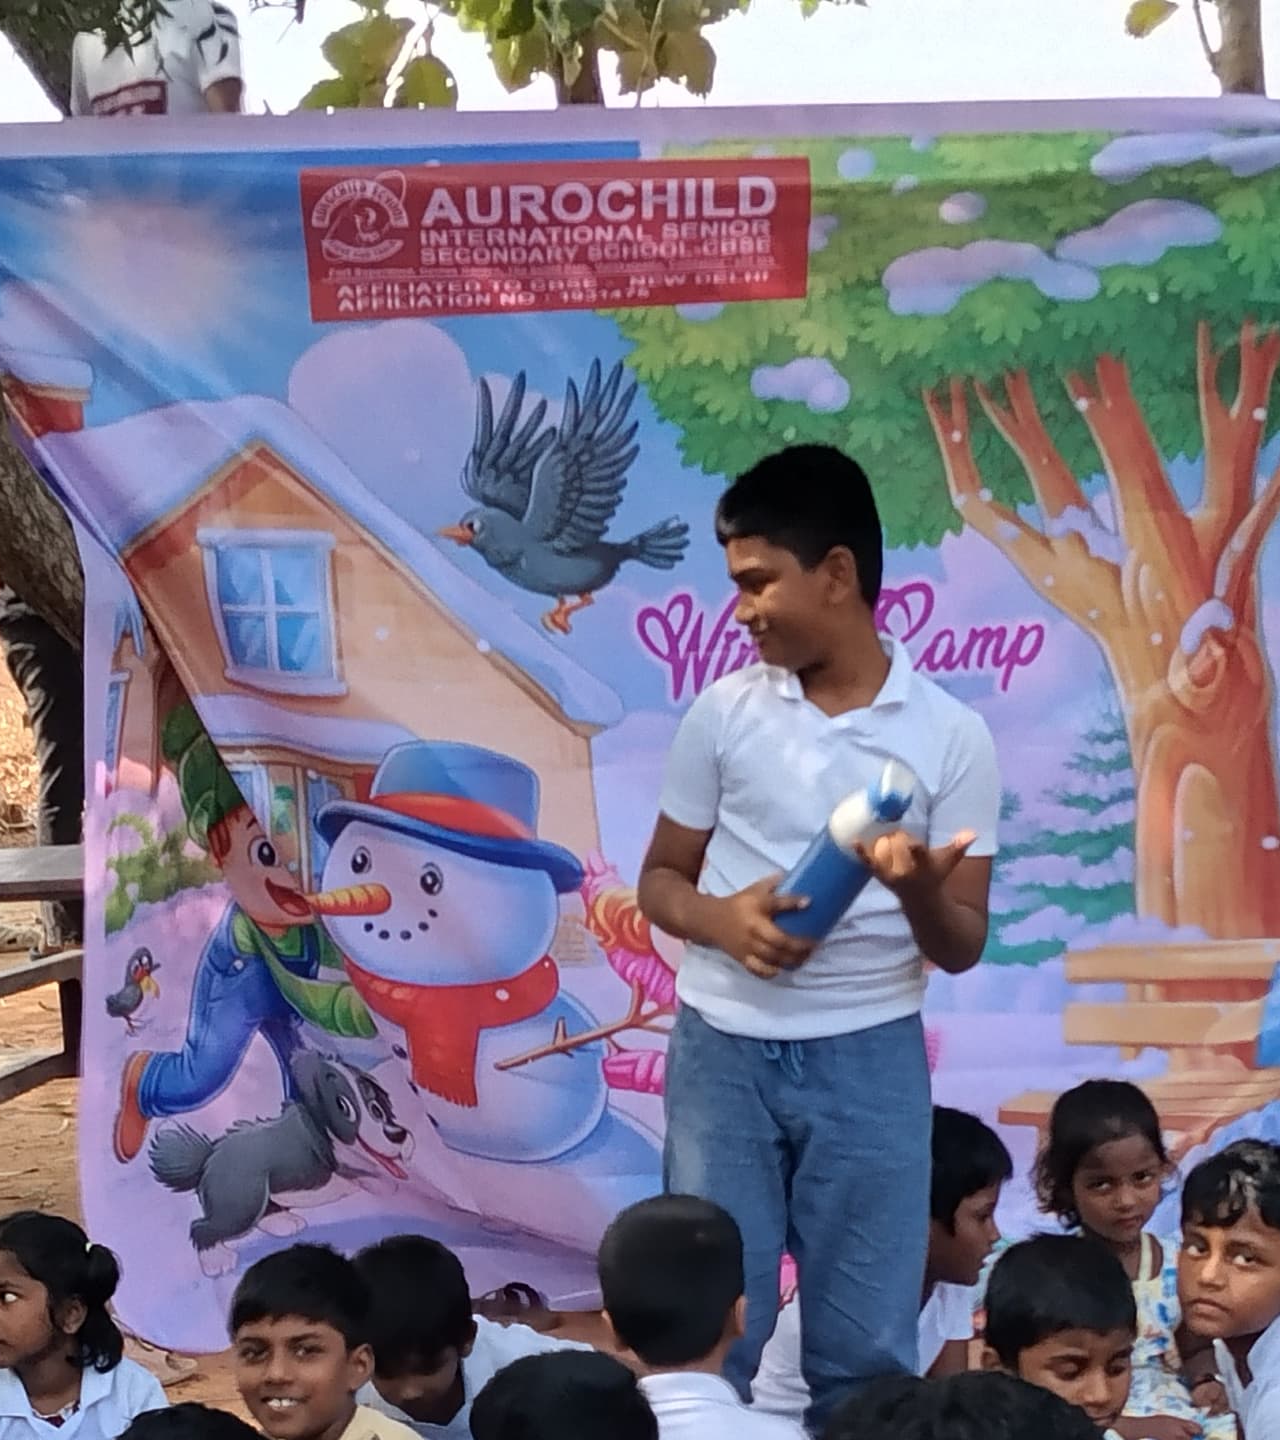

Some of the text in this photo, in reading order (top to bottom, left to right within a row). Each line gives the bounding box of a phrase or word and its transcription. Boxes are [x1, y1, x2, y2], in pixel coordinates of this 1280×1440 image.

[421, 176, 777, 227] AUROCHILD
[421, 218, 770, 247] INTERNATIONAL SENIOR
[420, 244, 579, 265] SECONDARY
